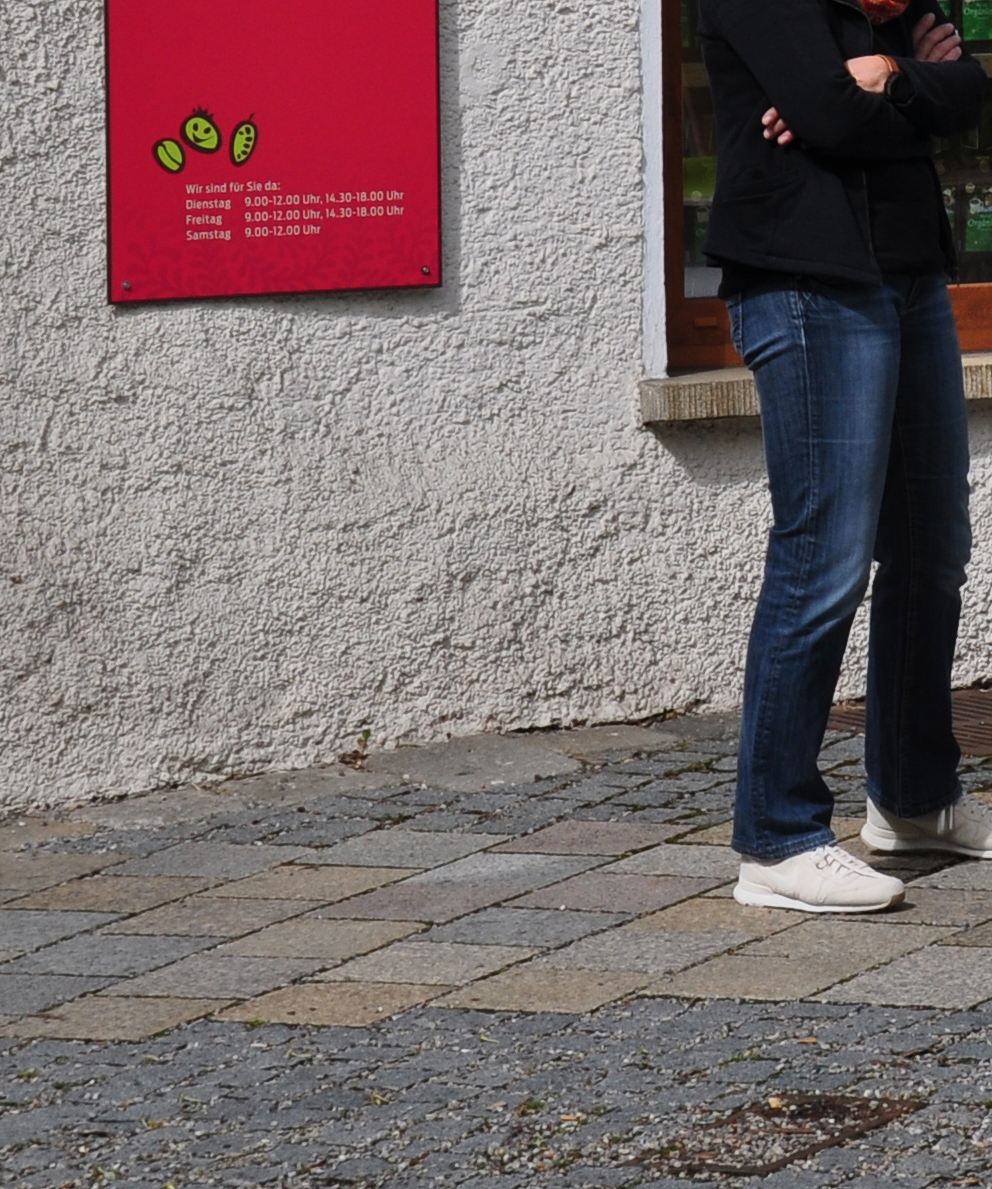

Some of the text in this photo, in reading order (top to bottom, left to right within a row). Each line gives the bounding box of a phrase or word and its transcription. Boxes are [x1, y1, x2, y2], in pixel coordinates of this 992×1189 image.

[185, 180, 282, 195] Wir sind für Sie da:
[185, 190, 405, 211] Dienstag 9.00-12.00 Uhr, 14.30-18.00 Uhr
[185, 205, 405, 226] Freitag 9.00-12.00 Uhr, 14.30-18.00 Uhr
[185, 224, 322, 241] Samstag 9.00-12.00 Uhr
